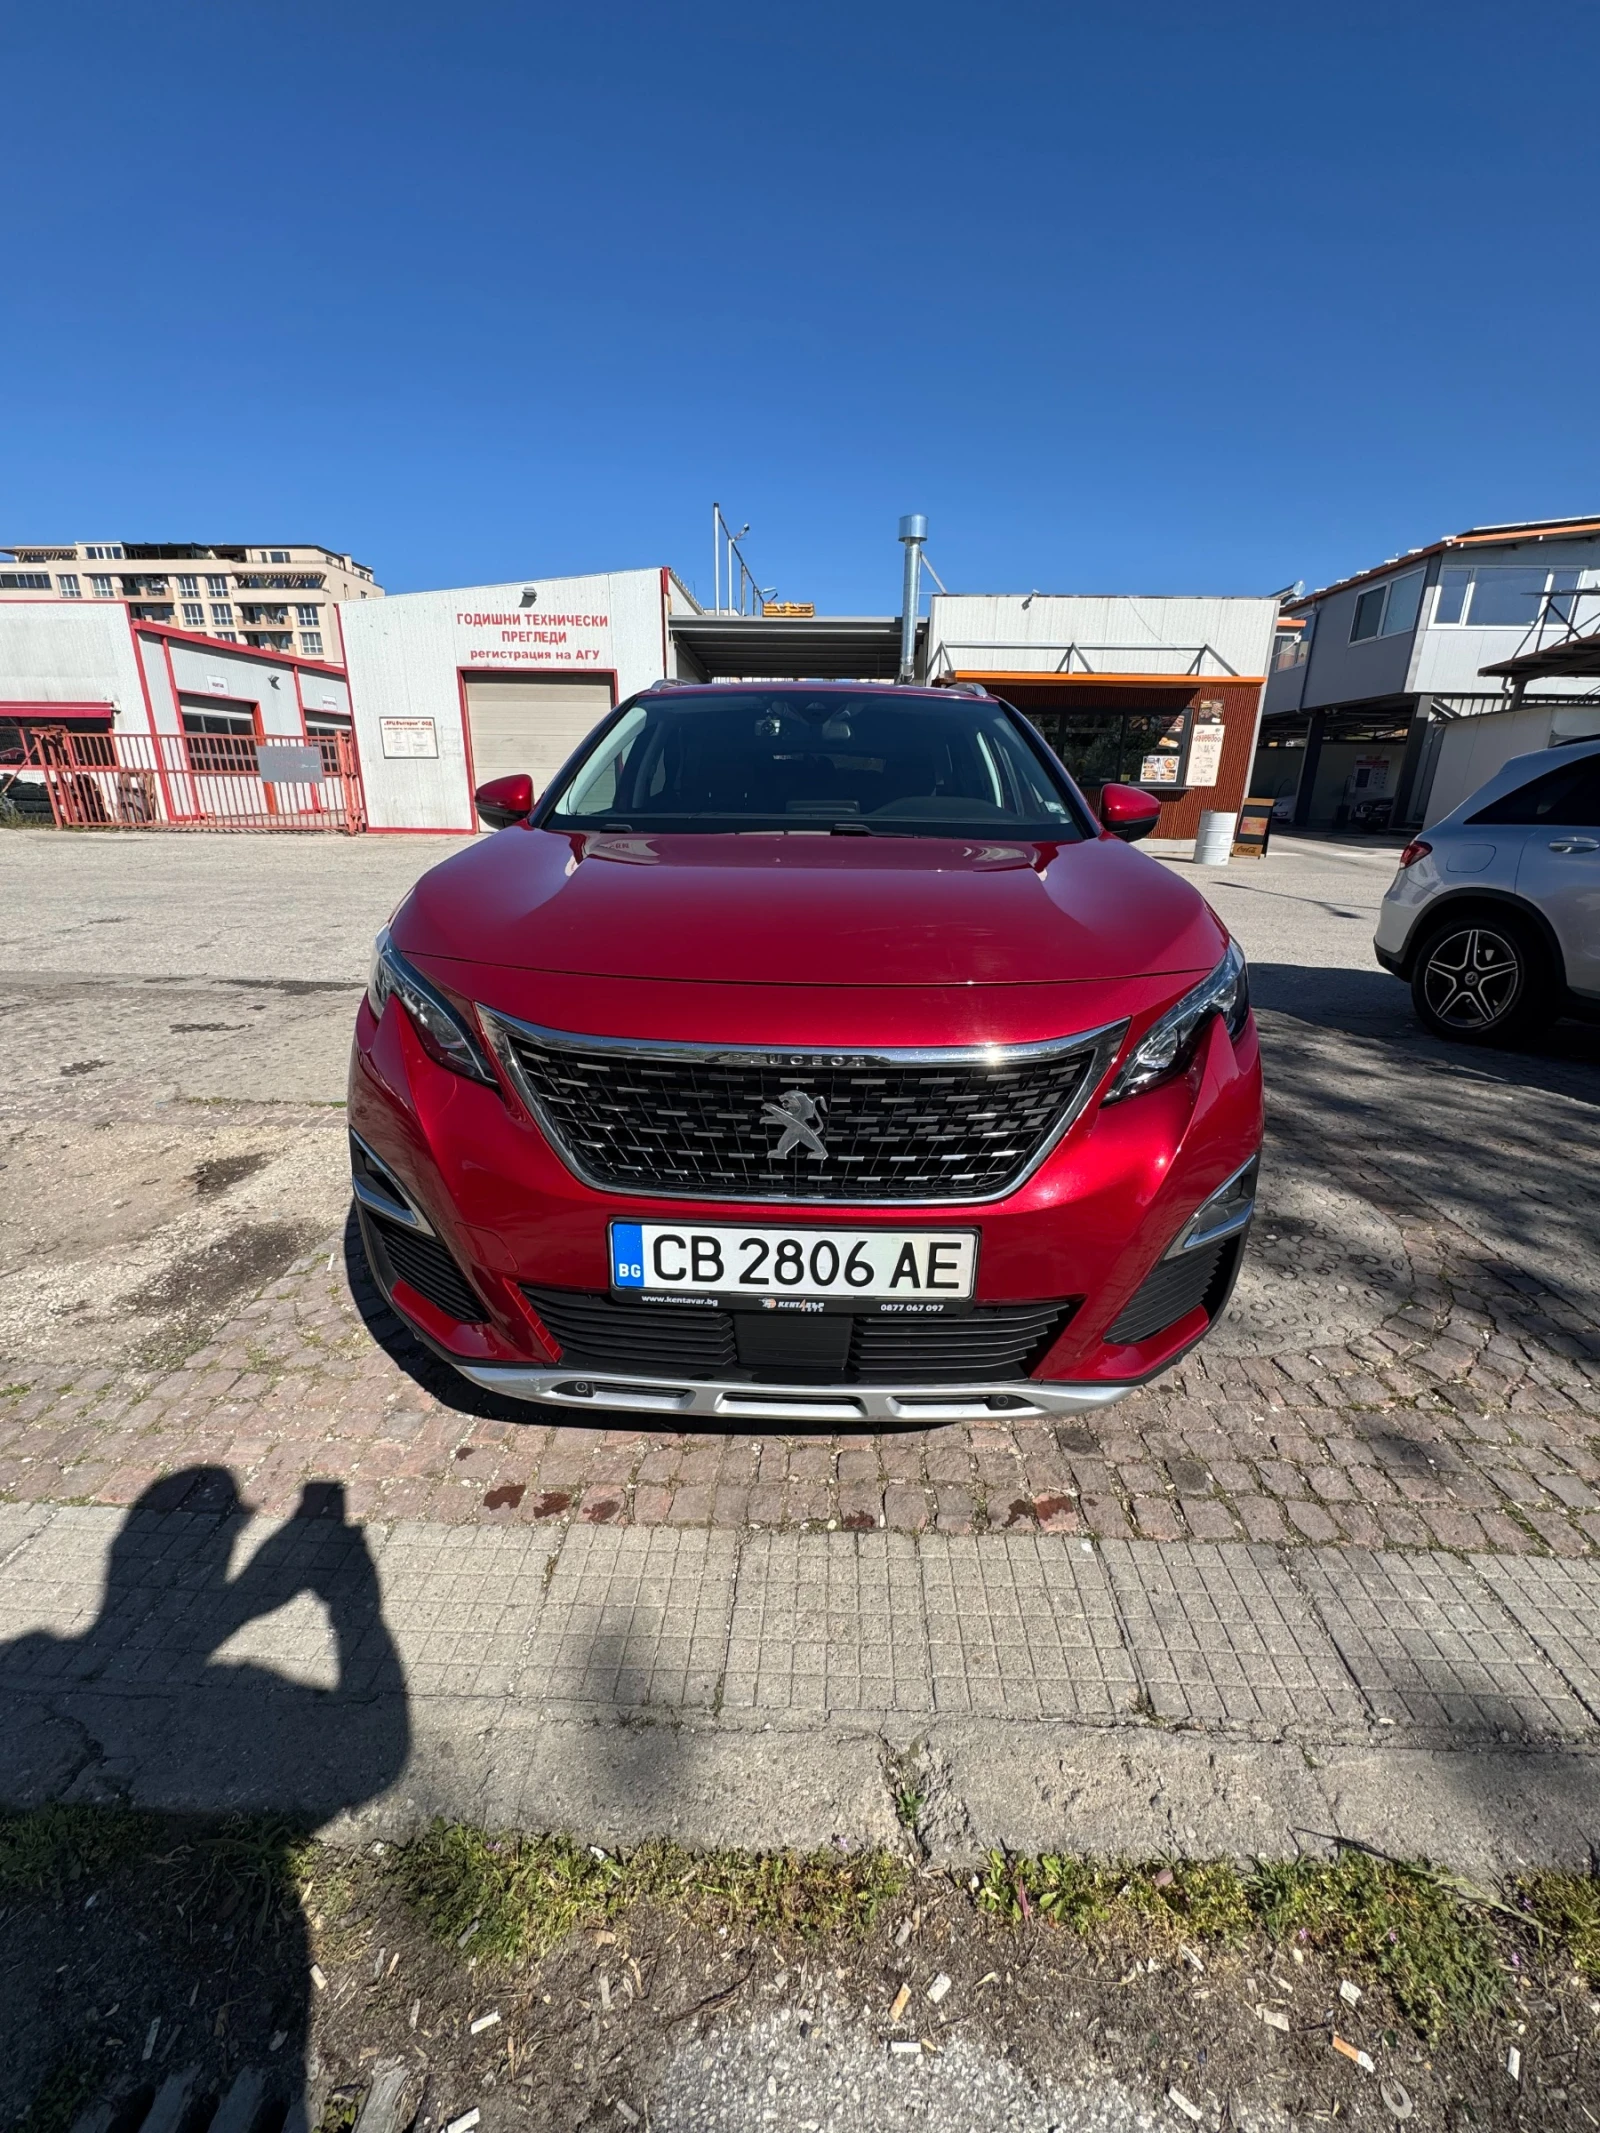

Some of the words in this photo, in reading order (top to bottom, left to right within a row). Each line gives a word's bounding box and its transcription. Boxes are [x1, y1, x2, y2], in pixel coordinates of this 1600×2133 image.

[457, 613, 521, 627] ГОДИШНИ
[525, 614, 608, 627] ТЕХНИЧЕСКИ
[502, 631, 567, 645] ПРЕГЛЕДИ
[470, 650, 551, 661] регистрация
[556, 651, 571, 660] на
[576, 650, 600, 660] АГУ
[653, 1234, 724, 1282] CB
[739, 1237, 874, 1287] 2806
[889, 1242, 961, 1288] AE
[618, 1263, 641, 1278] BG
[642, 1295, 718, 1306] www.kentavar.bg
[881, 1304, 904, 1312] 0877
[906, 1304, 923, 1312] 067
